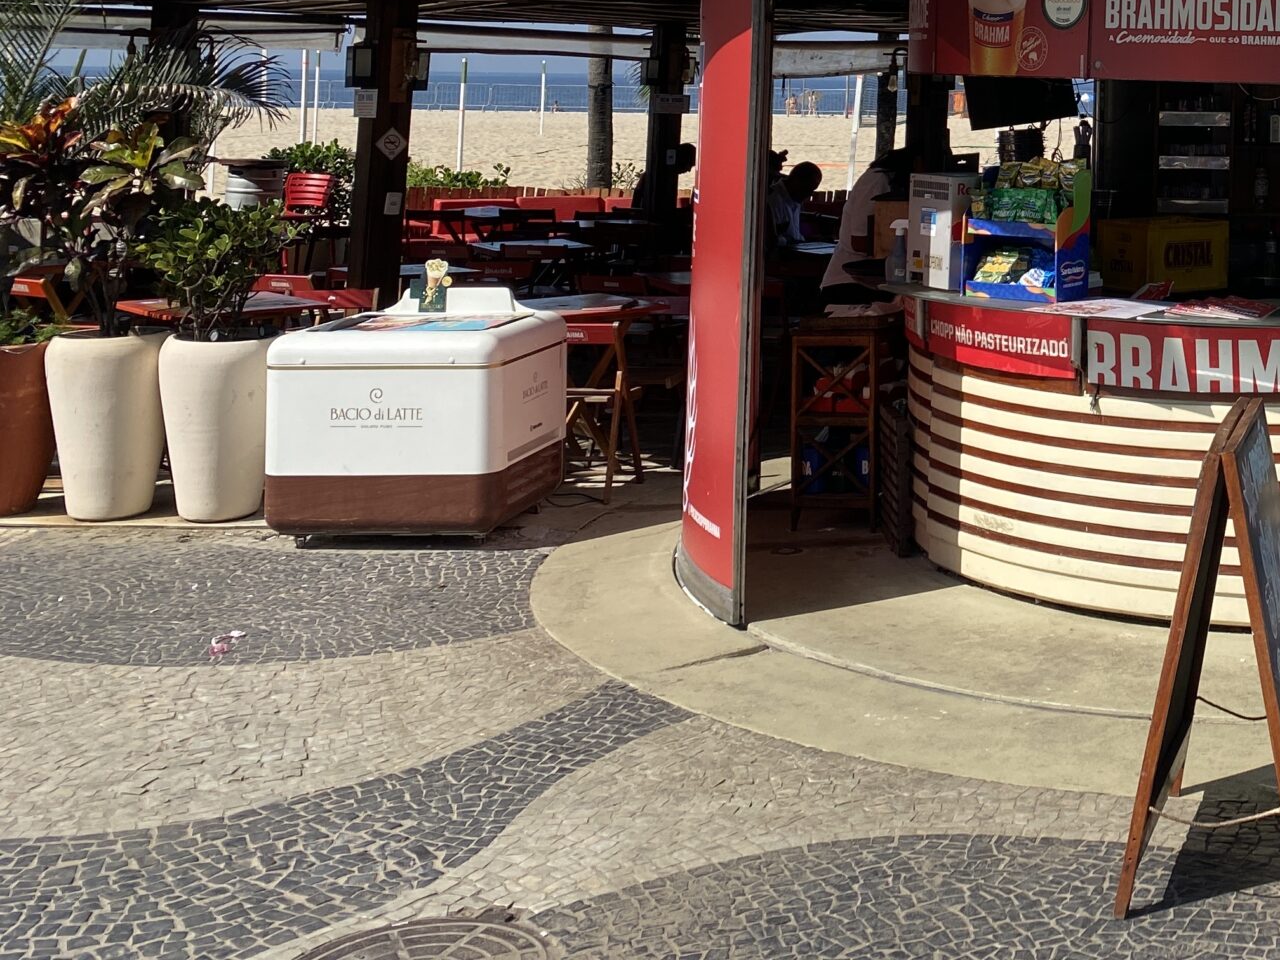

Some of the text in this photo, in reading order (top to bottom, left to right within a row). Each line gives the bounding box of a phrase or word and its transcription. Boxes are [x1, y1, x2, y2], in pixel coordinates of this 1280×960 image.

[974, 21, 1010, 43] BRAHMA
[930, 319, 953, 339] CHOPP
[955, 324, 973, 346] NÃO
[330, 408, 423, 421] BACIO di LATTE
